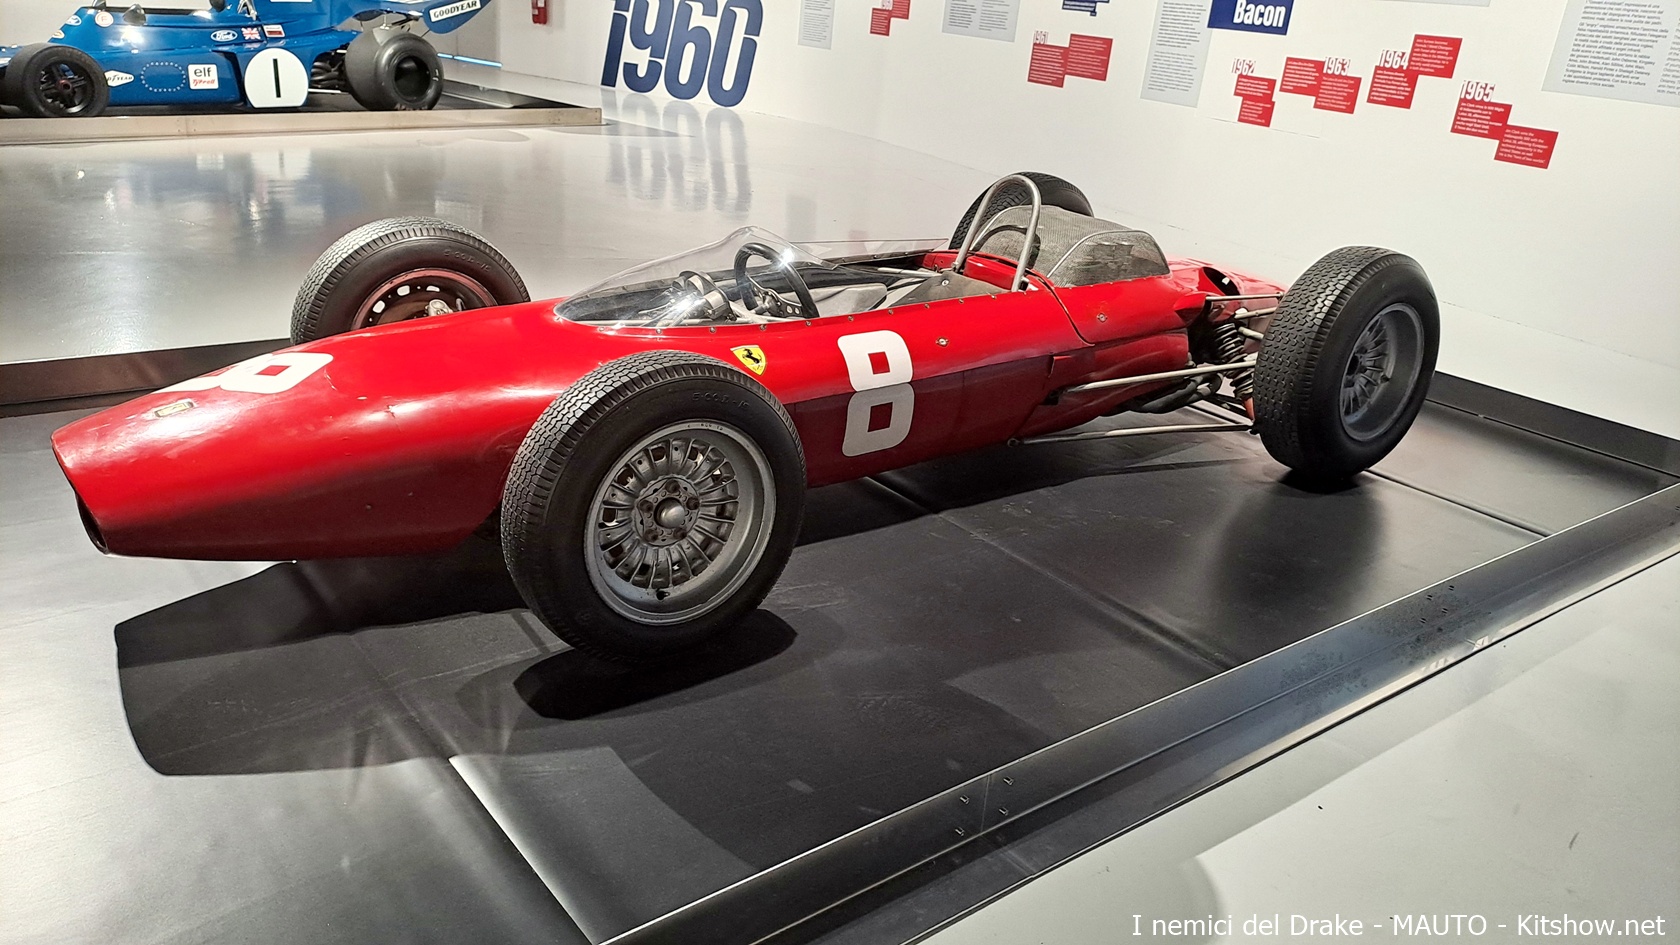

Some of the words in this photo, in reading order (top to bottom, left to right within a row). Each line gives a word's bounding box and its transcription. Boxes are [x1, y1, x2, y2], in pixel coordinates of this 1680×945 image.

[433, 0, 478, 18] GOODYEAR
[1233, 0, 1287, 28] Bacon
[601, 0, 764, 107] 1960
[1379, 49, 1409, 70] 1964
[194, 67, 212, 77] elf
[1231, 57, 1256, 75] 1962
[1323, 56, 1351, 76] 1963
[272, 58, 281, 98] 1
[1460, 80, 1496, 102] 1965
[151, 352, 334, 395] 8
[837, 330, 915, 457] 8
